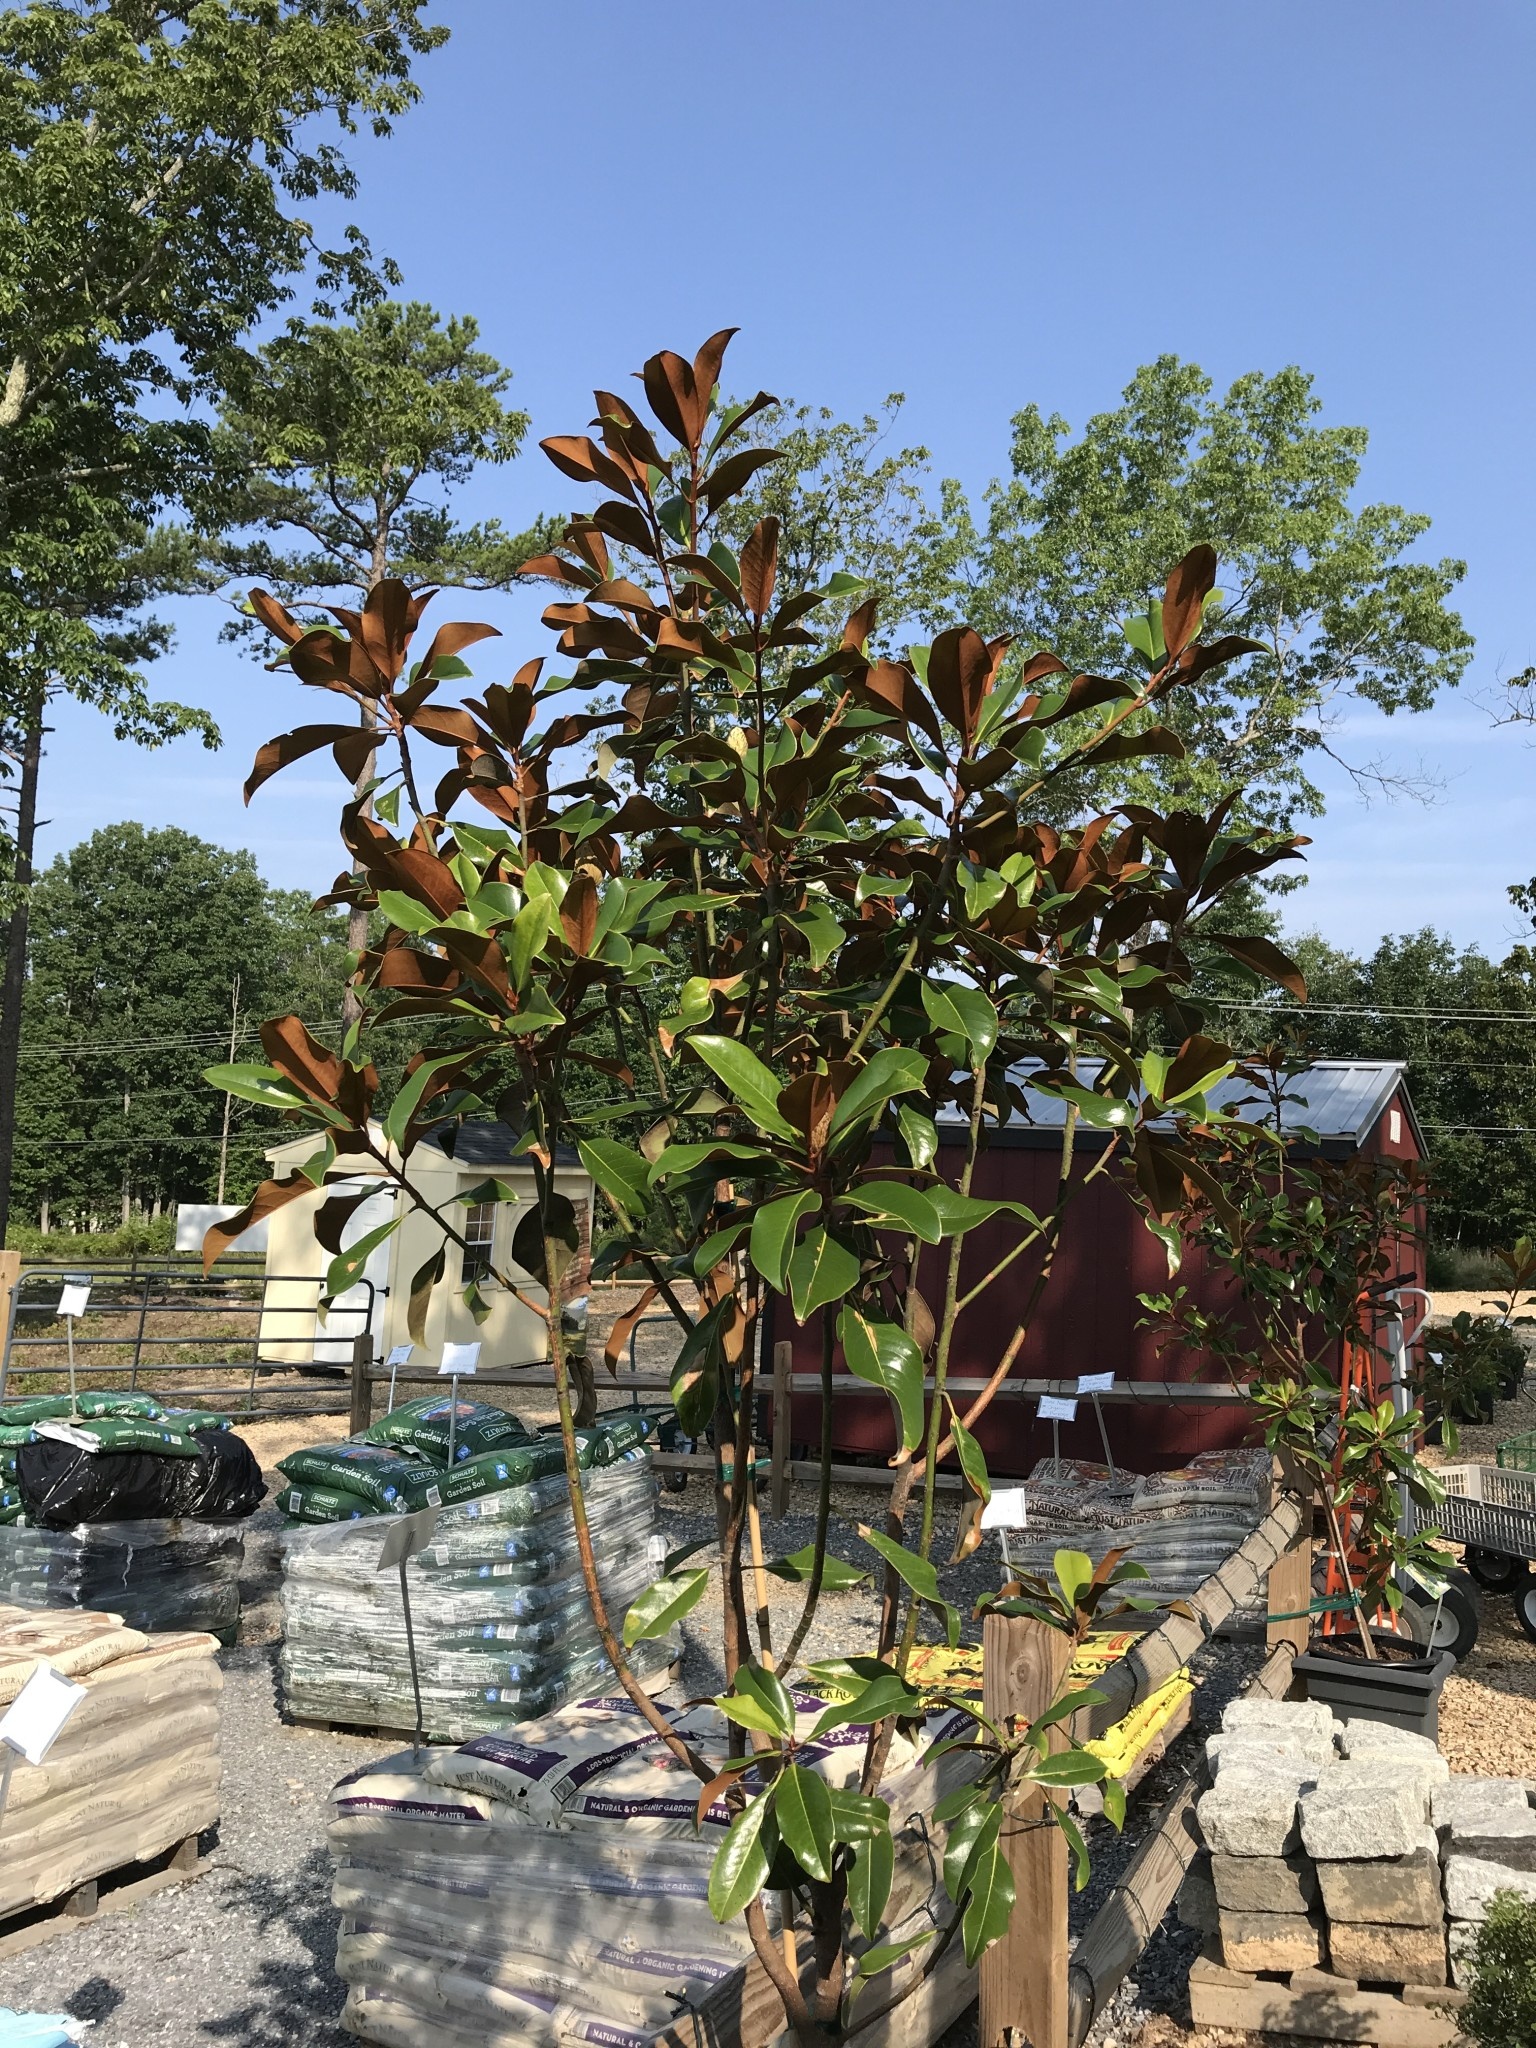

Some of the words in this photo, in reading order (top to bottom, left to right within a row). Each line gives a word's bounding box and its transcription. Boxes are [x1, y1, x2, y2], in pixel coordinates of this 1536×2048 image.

[415, 1430, 442, 1443] Garden
[331, 1464, 361, 1479] Garden
[362, 1475, 382, 1487] Soil
[451, 1468, 476, 1482] SCHULTZ
[447, 1484, 471, 1499] Garden
[472, 1478, 486, 1489] Soil
[313, 1493, 337, 1505] SCHULTZ
[304, 1506, 326, 1519] Garden
[327, 1512, 339, 1522] Soil
[454, 1568, 471, 1580] Soil
[457, 1628, 475, 1638] Soil
[836, 1689, 853, 1699] KO
[456, 1773, 474, 1784] JUST
[405, 1808, 438, 1818] ORGANIC
[439, 1811, 466, 1820] MATTER
[590, 1801, 622, 1812] NATURAL
[631, 1804, 664, 1813] ORGANIC
[707, 1808, 715, 1817] IS
[642, 1957, 675, 1971] ORGANIC
[593, 2028, 626, 2046] NATURAL
